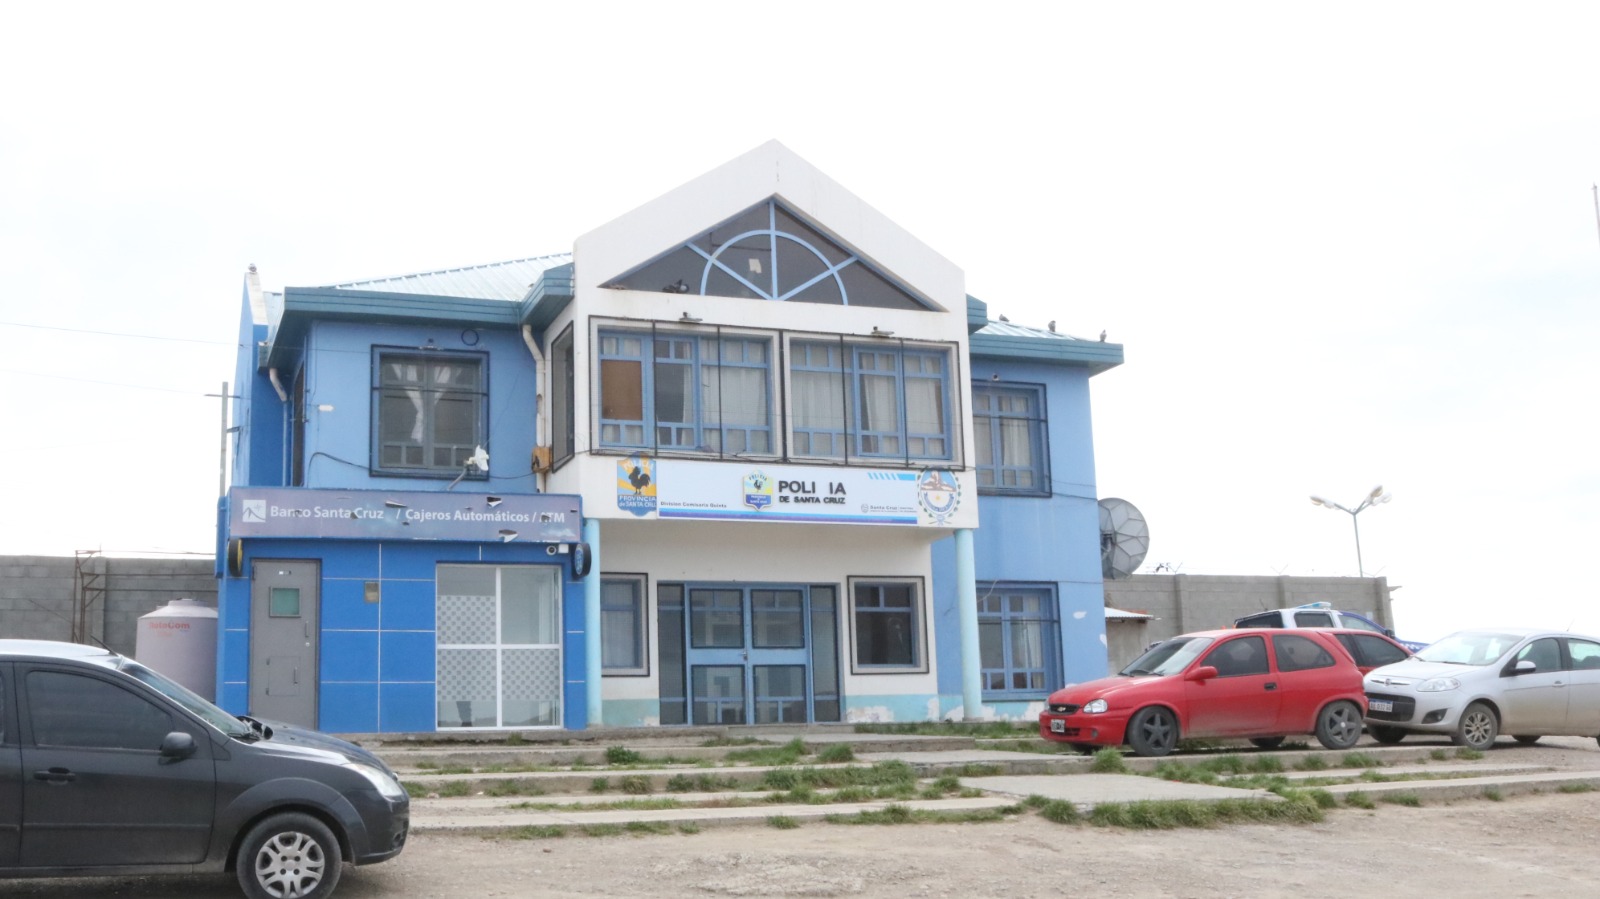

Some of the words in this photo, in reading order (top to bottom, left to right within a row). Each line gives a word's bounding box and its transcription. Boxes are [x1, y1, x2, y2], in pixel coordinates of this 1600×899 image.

[779, 495, 790, 503] DE
[793, 496, 821, 504] SANTA
[823, 497, 846, 505] CRUZ
[270, 506, 311, 518] Banco
[314, 506, 351, 518] Santa
[354, 507, 384, 519] Cruz
[405, 509, 451, 522] Cajeros
[454, 509, 529, 523] Automáticos
